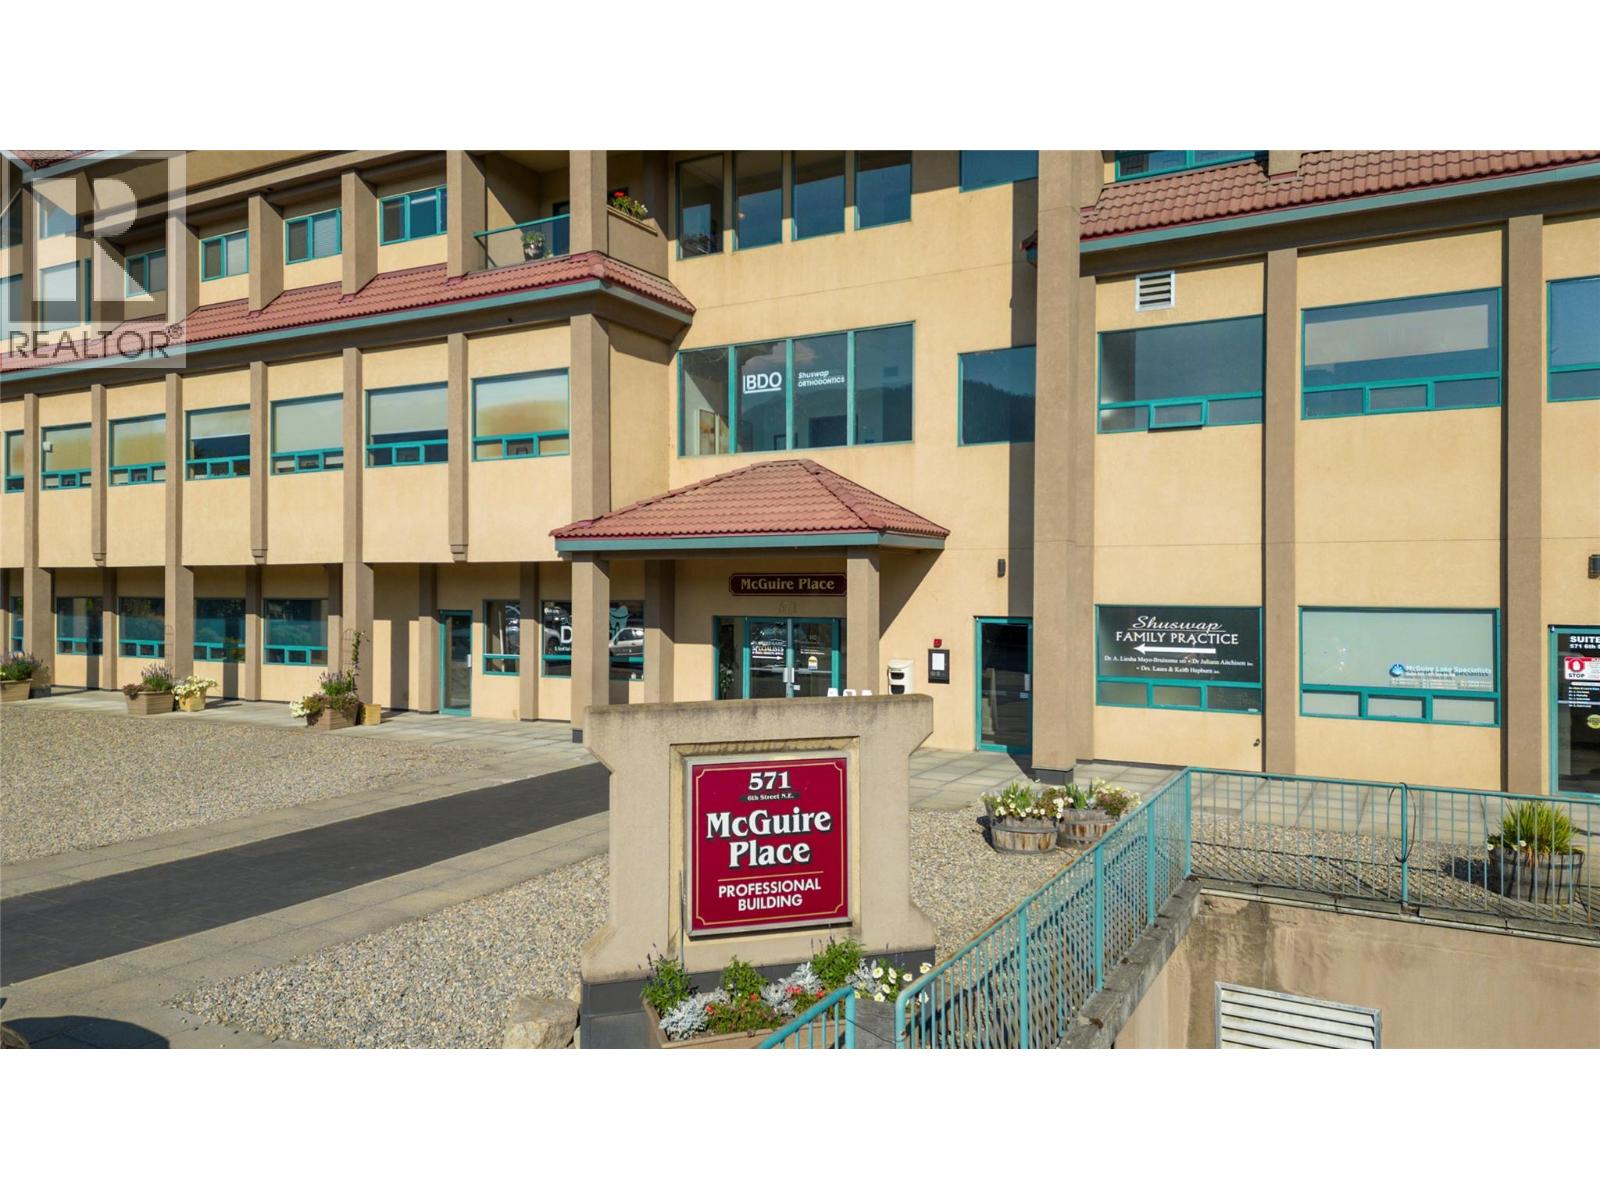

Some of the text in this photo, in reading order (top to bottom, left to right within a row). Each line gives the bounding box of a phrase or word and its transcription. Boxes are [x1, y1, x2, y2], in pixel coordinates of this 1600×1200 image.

[746, 371, 783, 390] BDO
[798, 370, 829, 379] Shuswap
[798, 376, 845, 388] ORTHODONTICS
[741, 578, 835, 590] McGuire Place
[1132, 615, 1223, 634] Shuswap
[1116, 631, 1239, 645] FAMILY PRACTICE
[748, 771, 792, 791] 571
[706, 806, 832, 839] McGuire
[729, 839, 811, 868] Place
[718, 878, 821, 898] PROFESSIONAL
[738, 894, 803, 911] BUILDING
